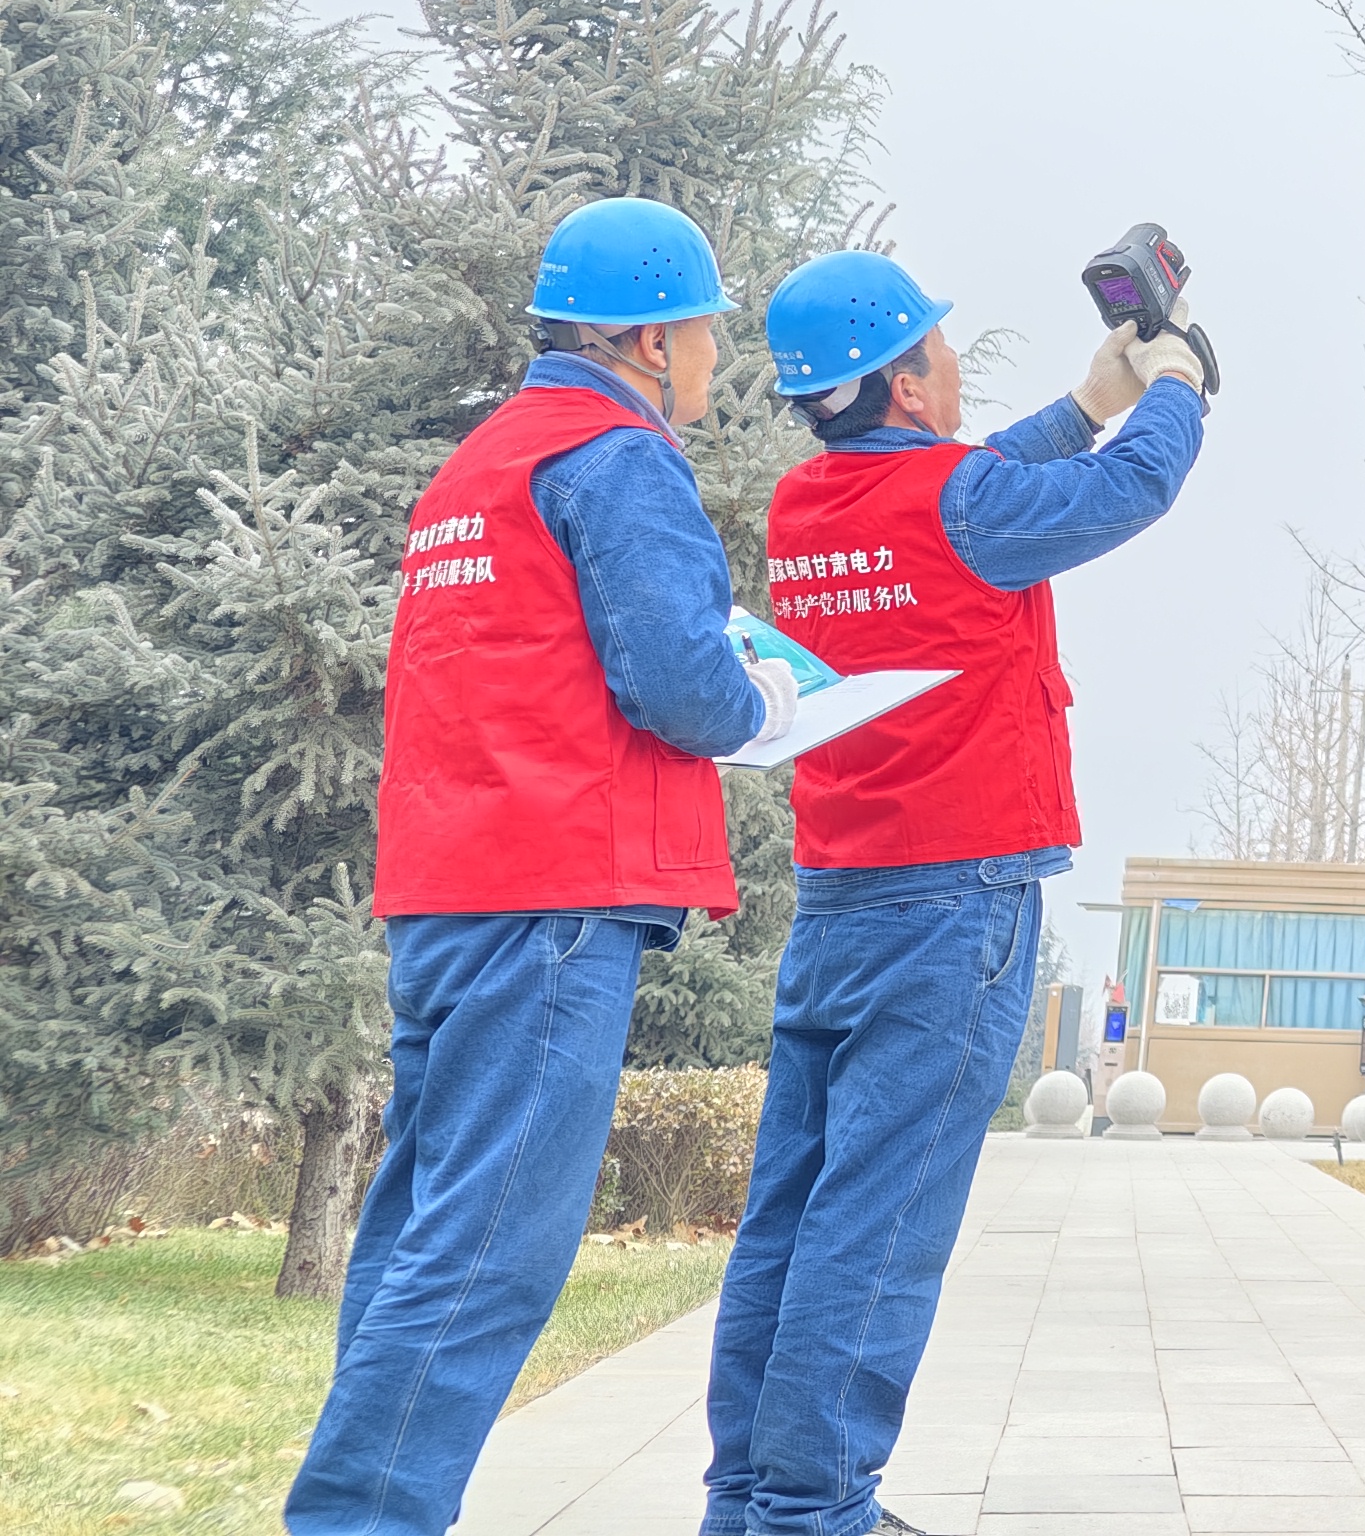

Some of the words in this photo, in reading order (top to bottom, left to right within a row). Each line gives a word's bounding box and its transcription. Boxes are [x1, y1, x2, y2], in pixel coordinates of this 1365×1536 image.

[768, 546, 893, 583] 国家电网甘肃电力
